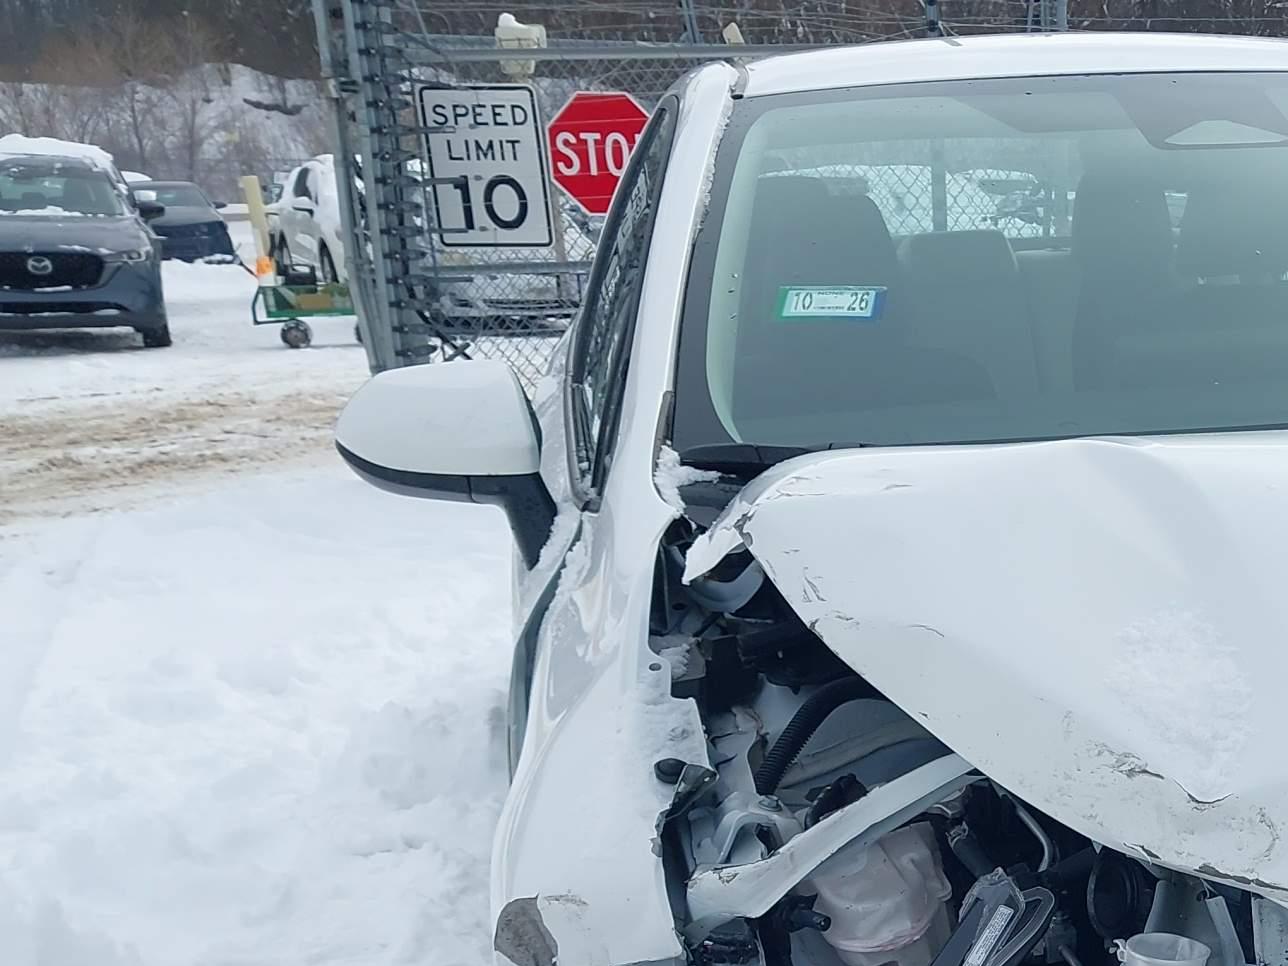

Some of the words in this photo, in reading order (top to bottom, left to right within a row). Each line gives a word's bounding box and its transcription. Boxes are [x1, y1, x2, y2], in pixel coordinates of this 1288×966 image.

[432, 104, 528, 126] SPEED
[446, 139, 521, 161] LIMIT
[555, 131, 640, 177] STO
[453, 174, 528, 231] 10
[793, 291, 813, 311] 10
[846, 291, 870, 312] 26
